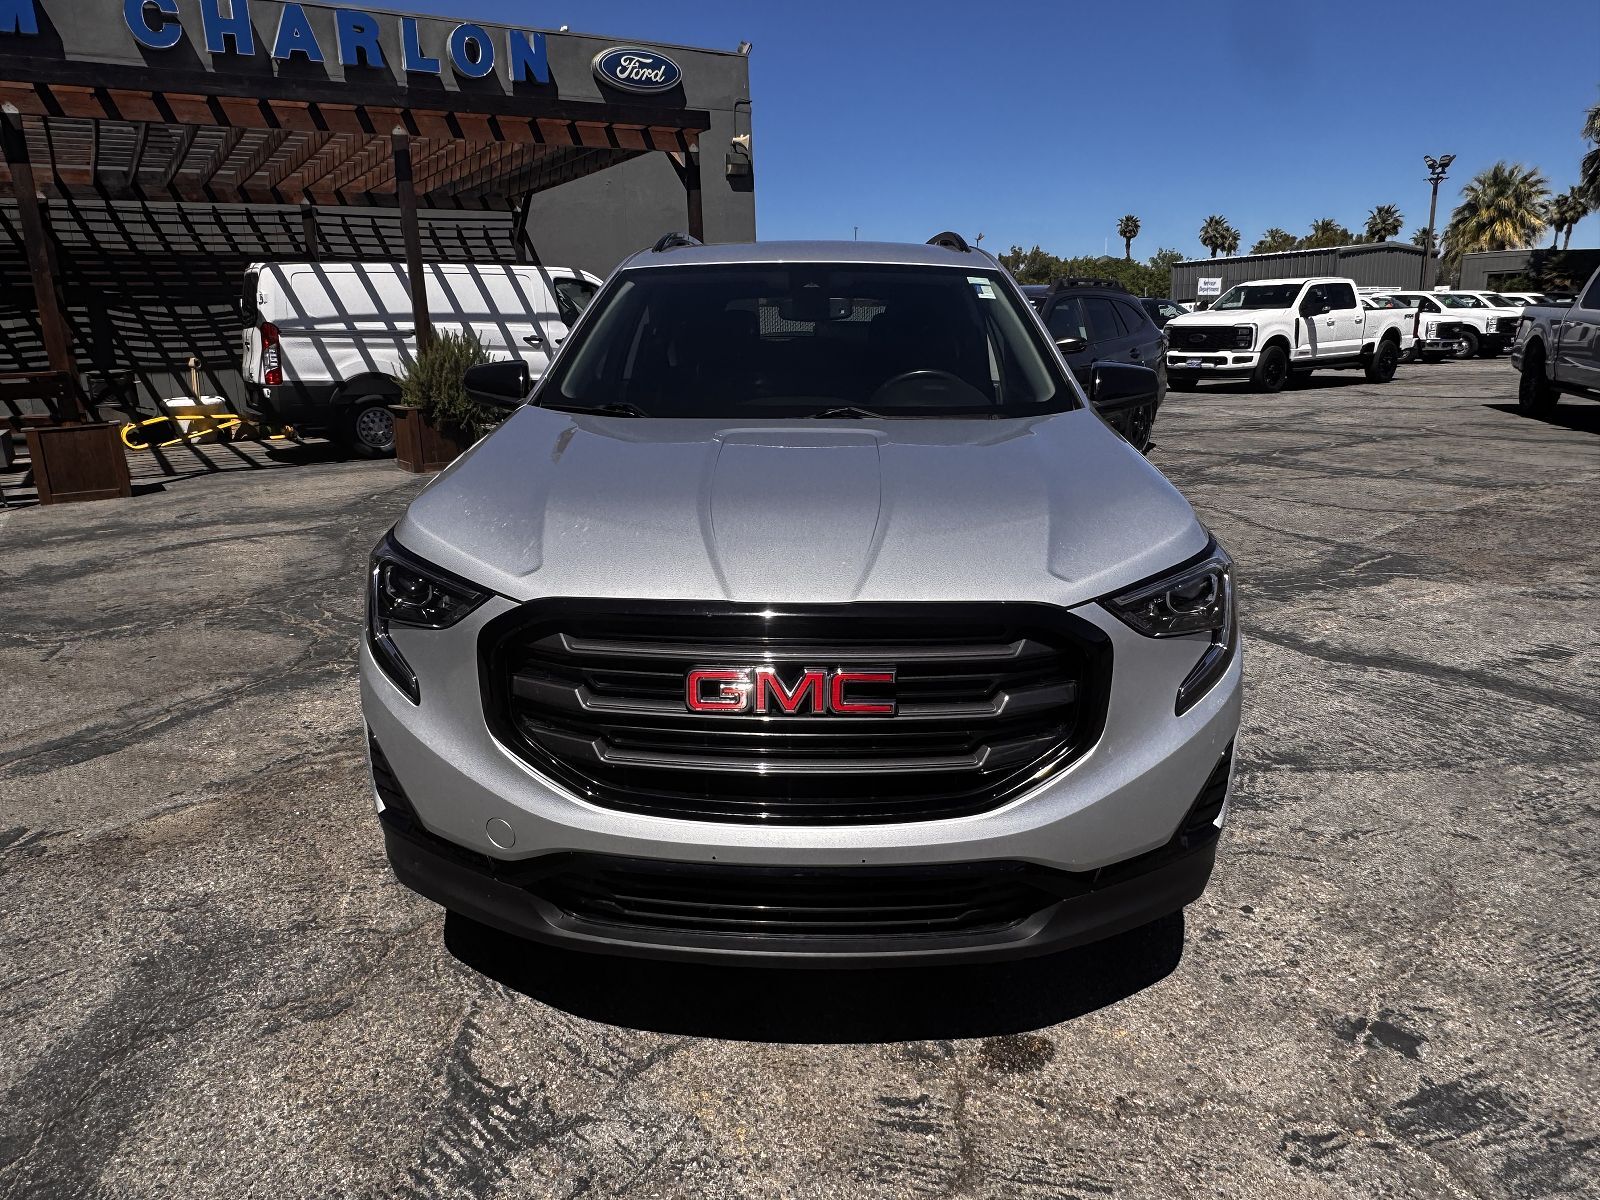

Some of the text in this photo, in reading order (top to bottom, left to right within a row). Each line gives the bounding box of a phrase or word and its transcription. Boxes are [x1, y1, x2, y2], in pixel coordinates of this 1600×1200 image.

[123, 0, 550, 83] CHARLON
[616, 55, 666, 83] Ford
[685, 665, 897, 714] GMC
